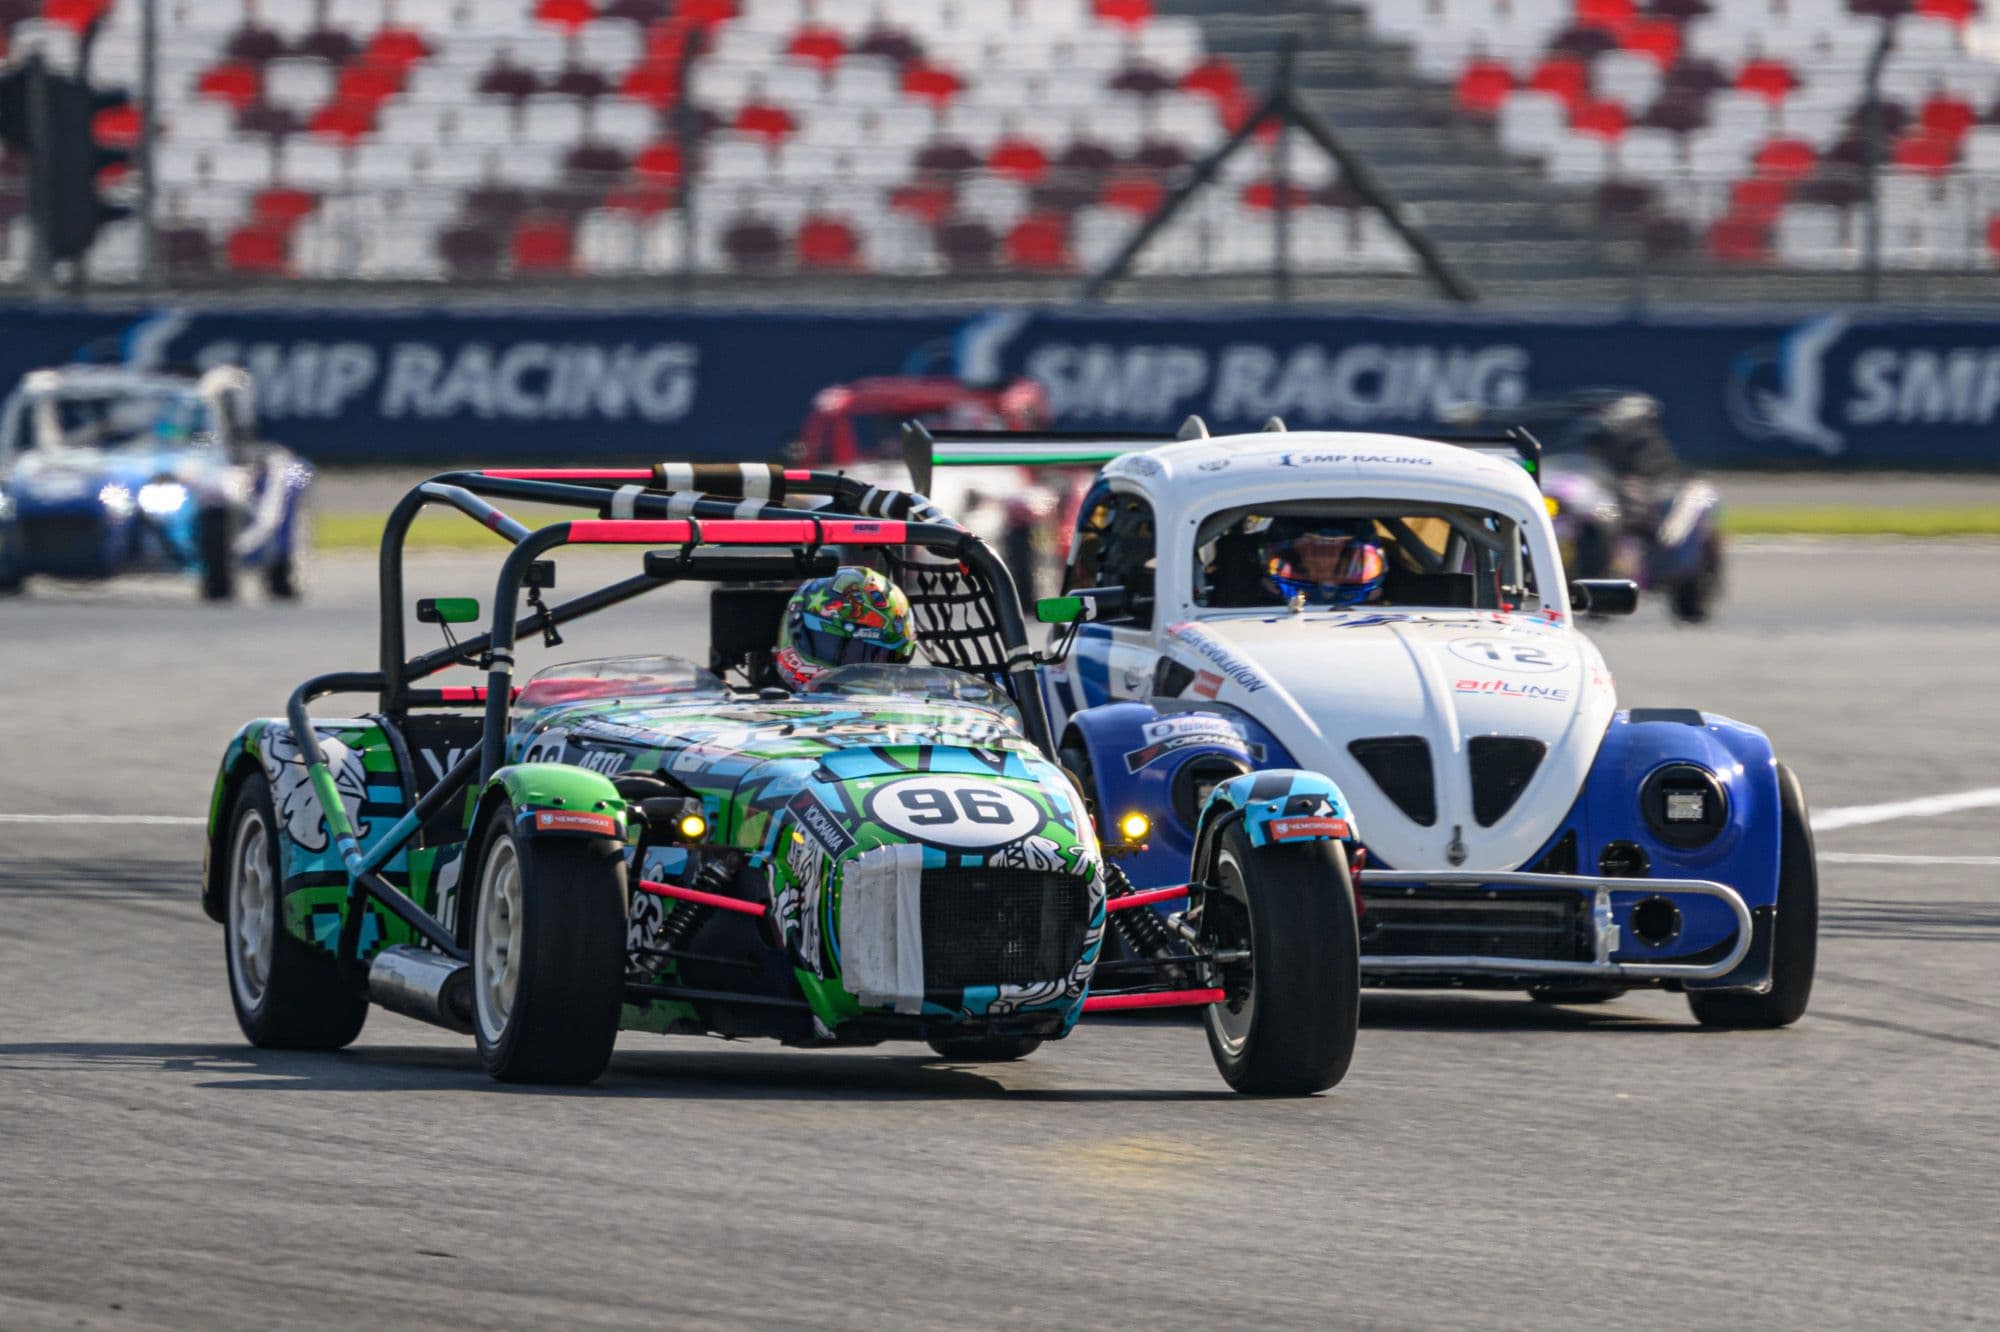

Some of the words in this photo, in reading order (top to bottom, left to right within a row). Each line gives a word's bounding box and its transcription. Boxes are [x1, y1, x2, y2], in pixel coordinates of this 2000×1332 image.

[382, 341, 697, 421] RACING
[1028, 344, 1208, 422] SMP
[1211, 343, 1529, 422] RACING
[1301, 454, 1347, 464] SMP
[1353, 455, 1432, 465] RACING
[1466, 641, 1553, 666] 12
[803, 804, 844, 852] YOKOHAMA
[897, 788, 1015, 826] 96
